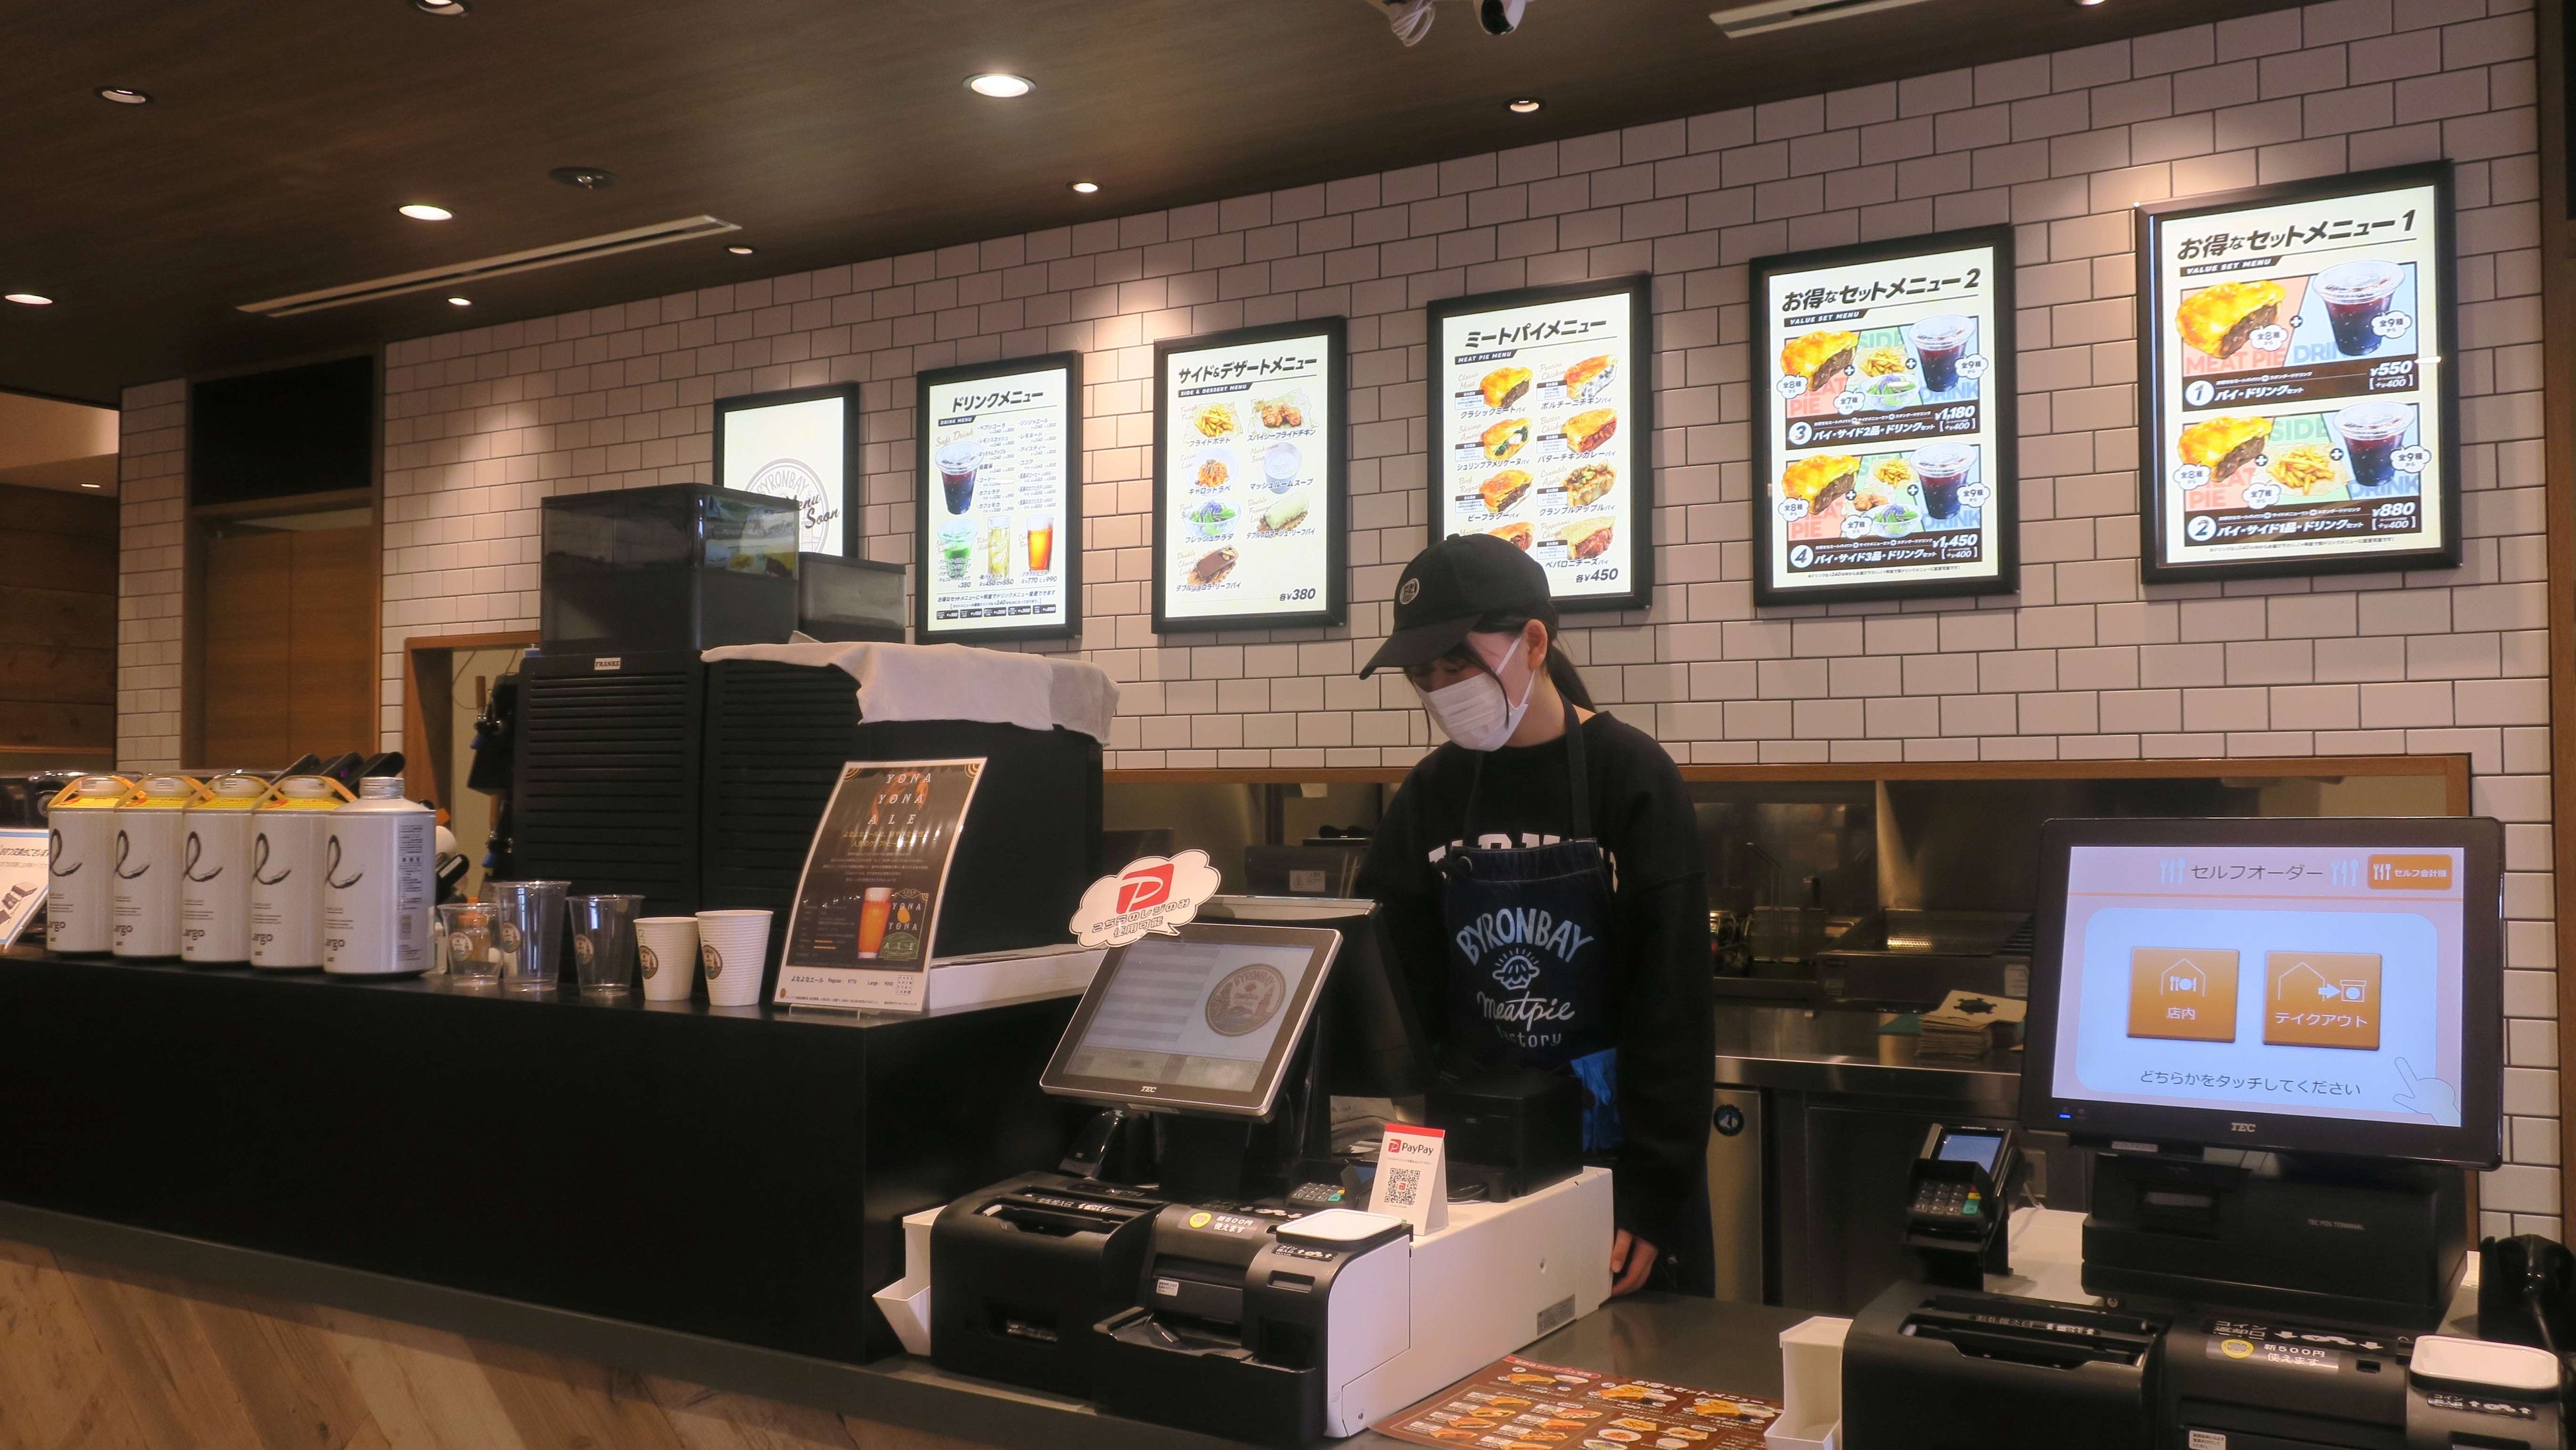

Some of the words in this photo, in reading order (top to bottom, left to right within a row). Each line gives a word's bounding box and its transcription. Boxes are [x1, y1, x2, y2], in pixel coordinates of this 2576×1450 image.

[2186, 264, 2218, 275] VALUE
[2220, 262, 2241, 272] SET
[2243, 258, 2272, 269] MENU
[1790, 315, 1816, 326] VALUE
[1818, 314, 1834, 322] SET
[1836, 311, 1860, 320] MENU
[1465, 320, 1607, 348] ミートパイメニュー
[1178, 356, 1317, 384] サイド&デザートメニュー
[2369, 360, 2413, 377] ¥550
[2214, 385, 2304, 401] パイ・ドリンクセット
[952, 391, 1044, 413] ドリンクメニュー
[1460, 406, 1526, 419] クラシックミートパイ
[1935, 405, 1975, 421] ¥1,180
[953, 427, 974, 441] Drink
[1189, 437, 1231, 447] フライドポテト
[1537, 451, 1616, 463] バターチキンカレーパイ
[2372, 501, 2415, 517] ¥880
[805, 507, 839, 529] Soon
[1185, 533, 1234, 543] フレッシュサラダ
[1932, 533, 1978, 548] ¥1,450
[1576, 568, 1618, 583] 各¥450
[886, 772, 931, 784] YONA
[877, 793, 923, 805] YONA
[867, 814, 916, 825] ALE
[2191, 863, 2323, 882] セルフオーダー
[2394, 867, 2447, 879] セルフ会計機
[892, 902, 922, 911] YONA
[1092, 898, 1190, 933] こちらのレジのみ
[888, 922, 917, 931] YONA
[1114, 916, 1164, 938] 使用可能
[1456, 908, 1594, 966] BYRONBAY
[884, 942, 914, 951] ALE
[1477, 991, 1575, 1032] Meatpie
[2166, 1006, 2196, 1021] 店内
[2275, 1012, 2368, 1029] テイクアウト
[2140, 1071, 2361, 1097] どちらかをタッチしてください
[2231, 1122, 2256, 1133] TEC
[1402, 1143, 1434, 1155] PayPay
[1213, 1223, 1245, 1234] 使えます
[1216, 1215, 1254, 1227] 新500円
[2264, 1344, 2325, 1358] 新500円
[2267, 1353, 2320, 1366] 使えます
